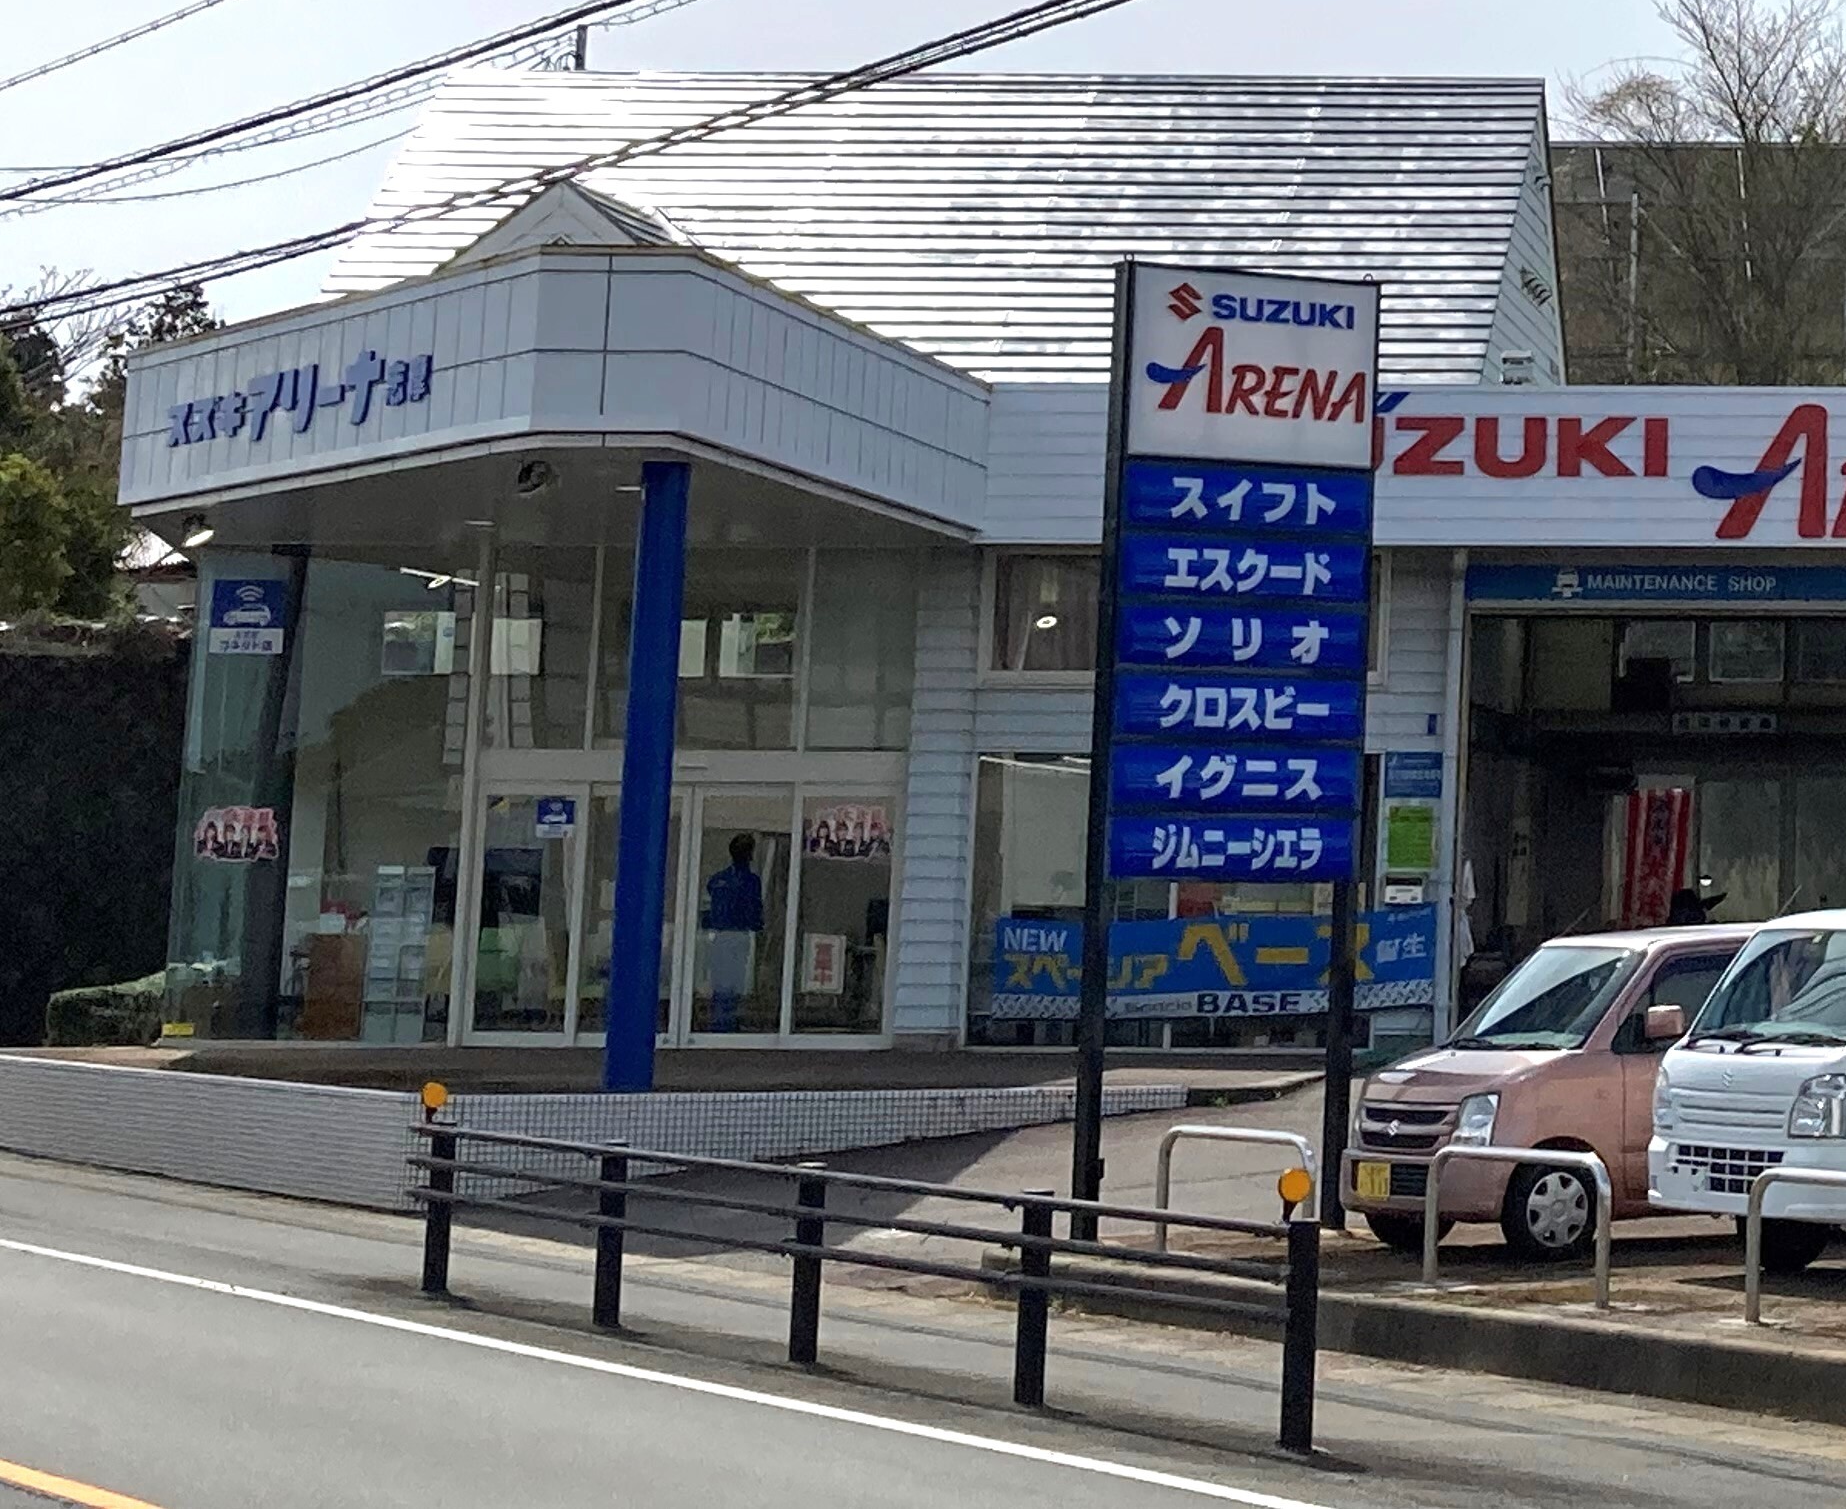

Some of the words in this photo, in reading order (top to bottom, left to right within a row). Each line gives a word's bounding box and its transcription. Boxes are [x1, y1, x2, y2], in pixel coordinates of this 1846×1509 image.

[1211, 293, 1355, 330] SUZUKI
[1146, 326, 1366, 424] ARENA
[1371, 416, 1669, 478] ZUKI
[1170, 476, 1337, 525] スイフト
[1164, 547, 1332, 596] エスクード
[1587, 573, 1718, 592] MAINTENANCE
[1727, 575, 1777, 592] SHOP
[1164, 616, 1330, 664] ソリオ
[1160, 684, 1330, 731] クロスビー
[1156, 755, 1323, 801] イグニス
[1152, 824, 1323, 871] ジムニーシエラ
[1003, 927, 1068, 953] NEW
[1196, 992, 1302, 1014] BASE
